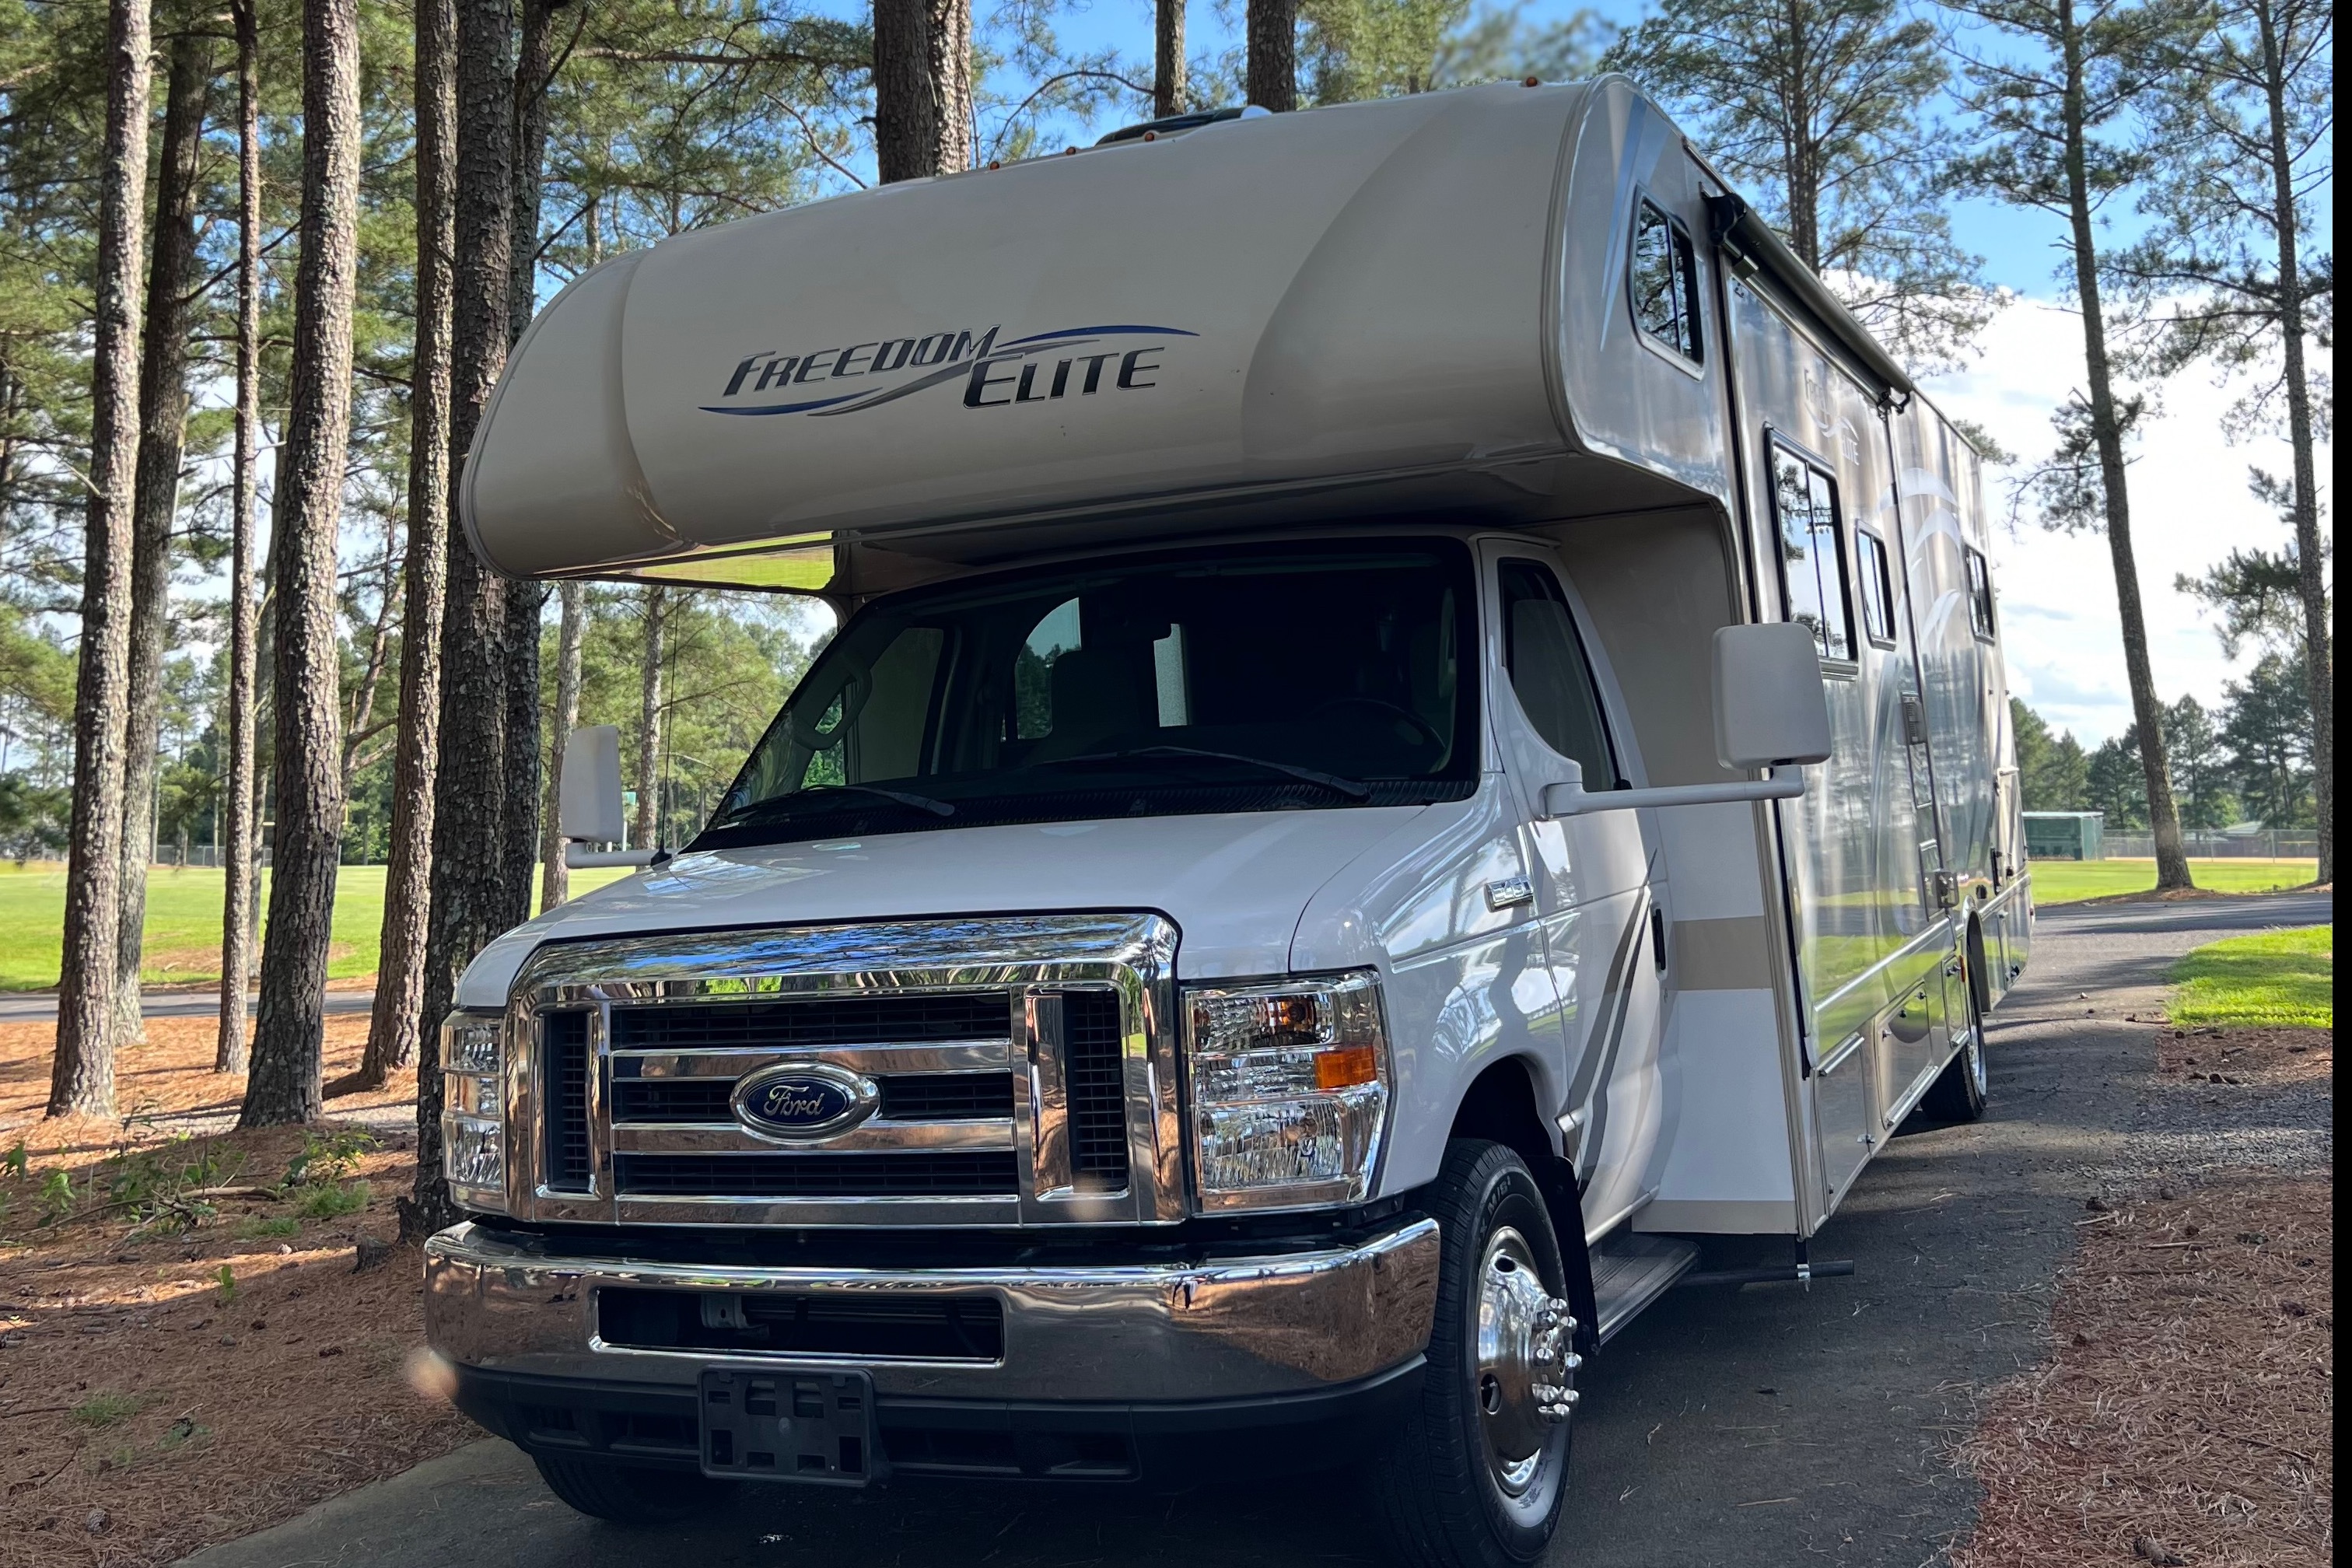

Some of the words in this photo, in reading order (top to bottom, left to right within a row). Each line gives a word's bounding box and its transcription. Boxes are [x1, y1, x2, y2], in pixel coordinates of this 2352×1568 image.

[723, 324, 1002, 397] FREEDOM
[962, 347, 1165, 410] ELITE
[763, 1085, 825, 1116] Ford
